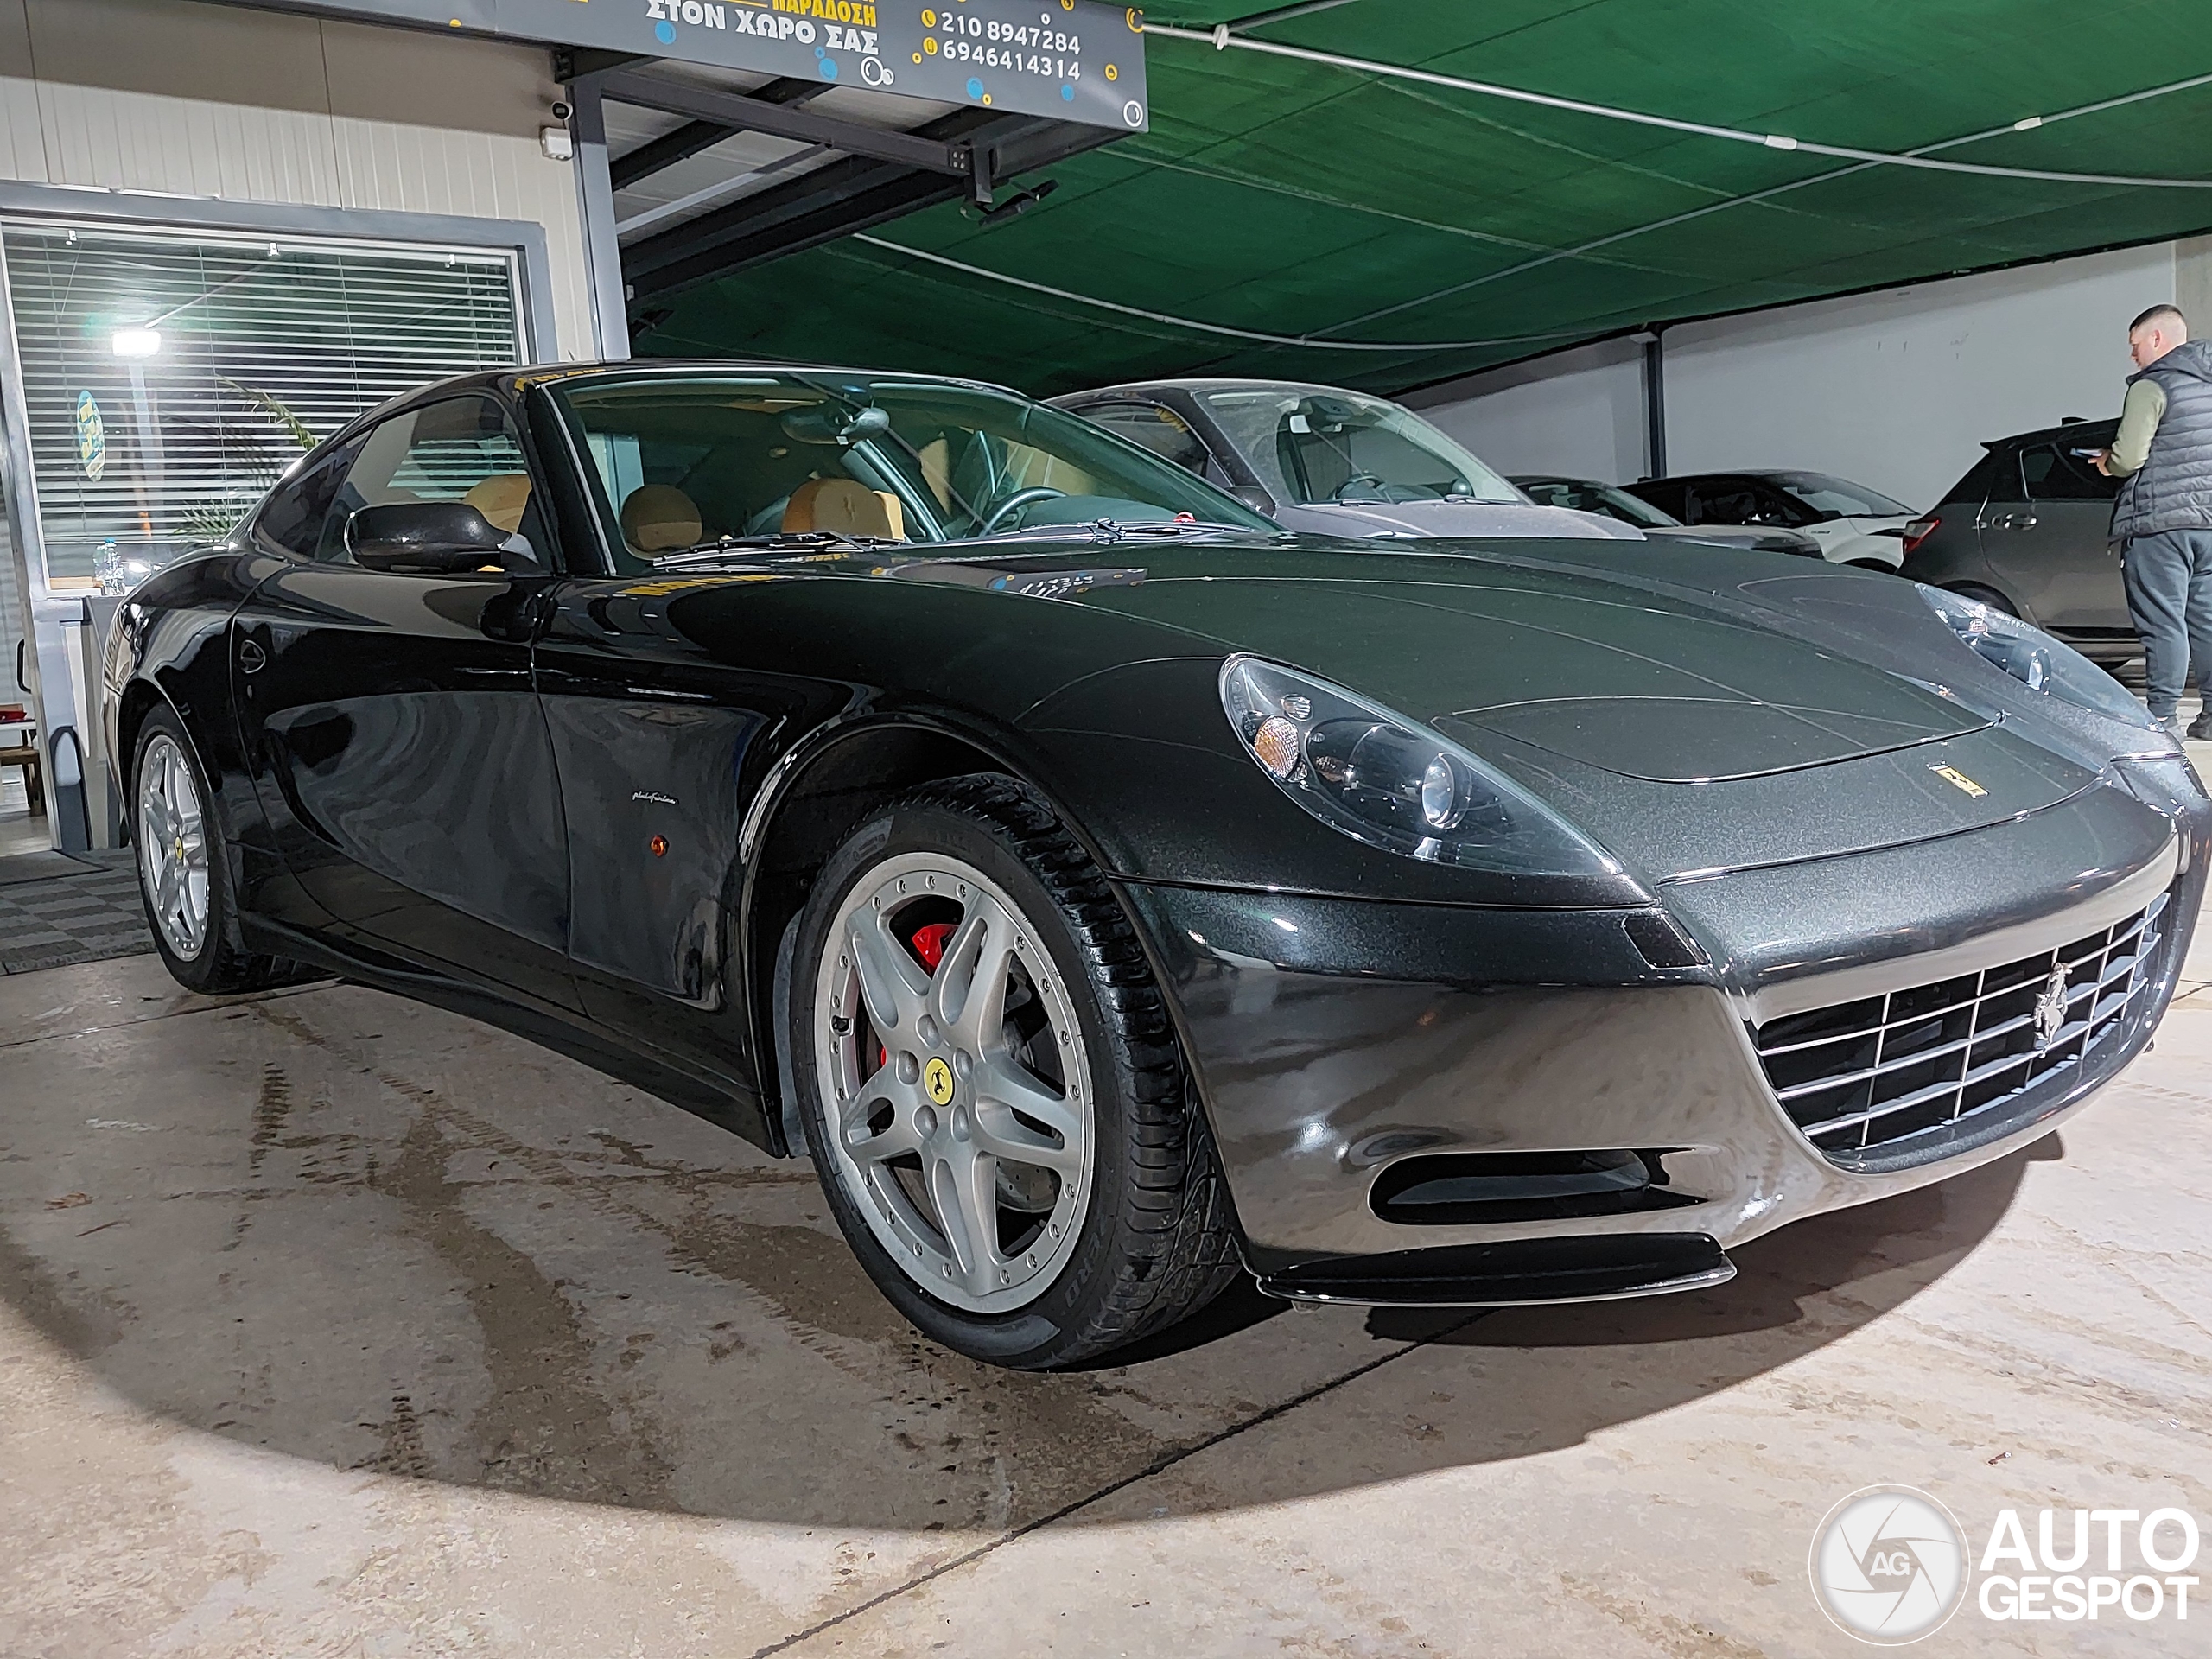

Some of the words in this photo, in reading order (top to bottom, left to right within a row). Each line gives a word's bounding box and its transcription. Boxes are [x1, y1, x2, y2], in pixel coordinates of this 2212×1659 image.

[645, 0, 726, 30] ΣΤΟΝ
[735, 9, 817, 44] ΧΩΡΟ
[823, 24, 879, 55] ΣΑΣ
[941, 12, 982, 37] 210
[987, 21, 1080, 55] 8947284
[943, 40, 1080, 80] 6946414314
